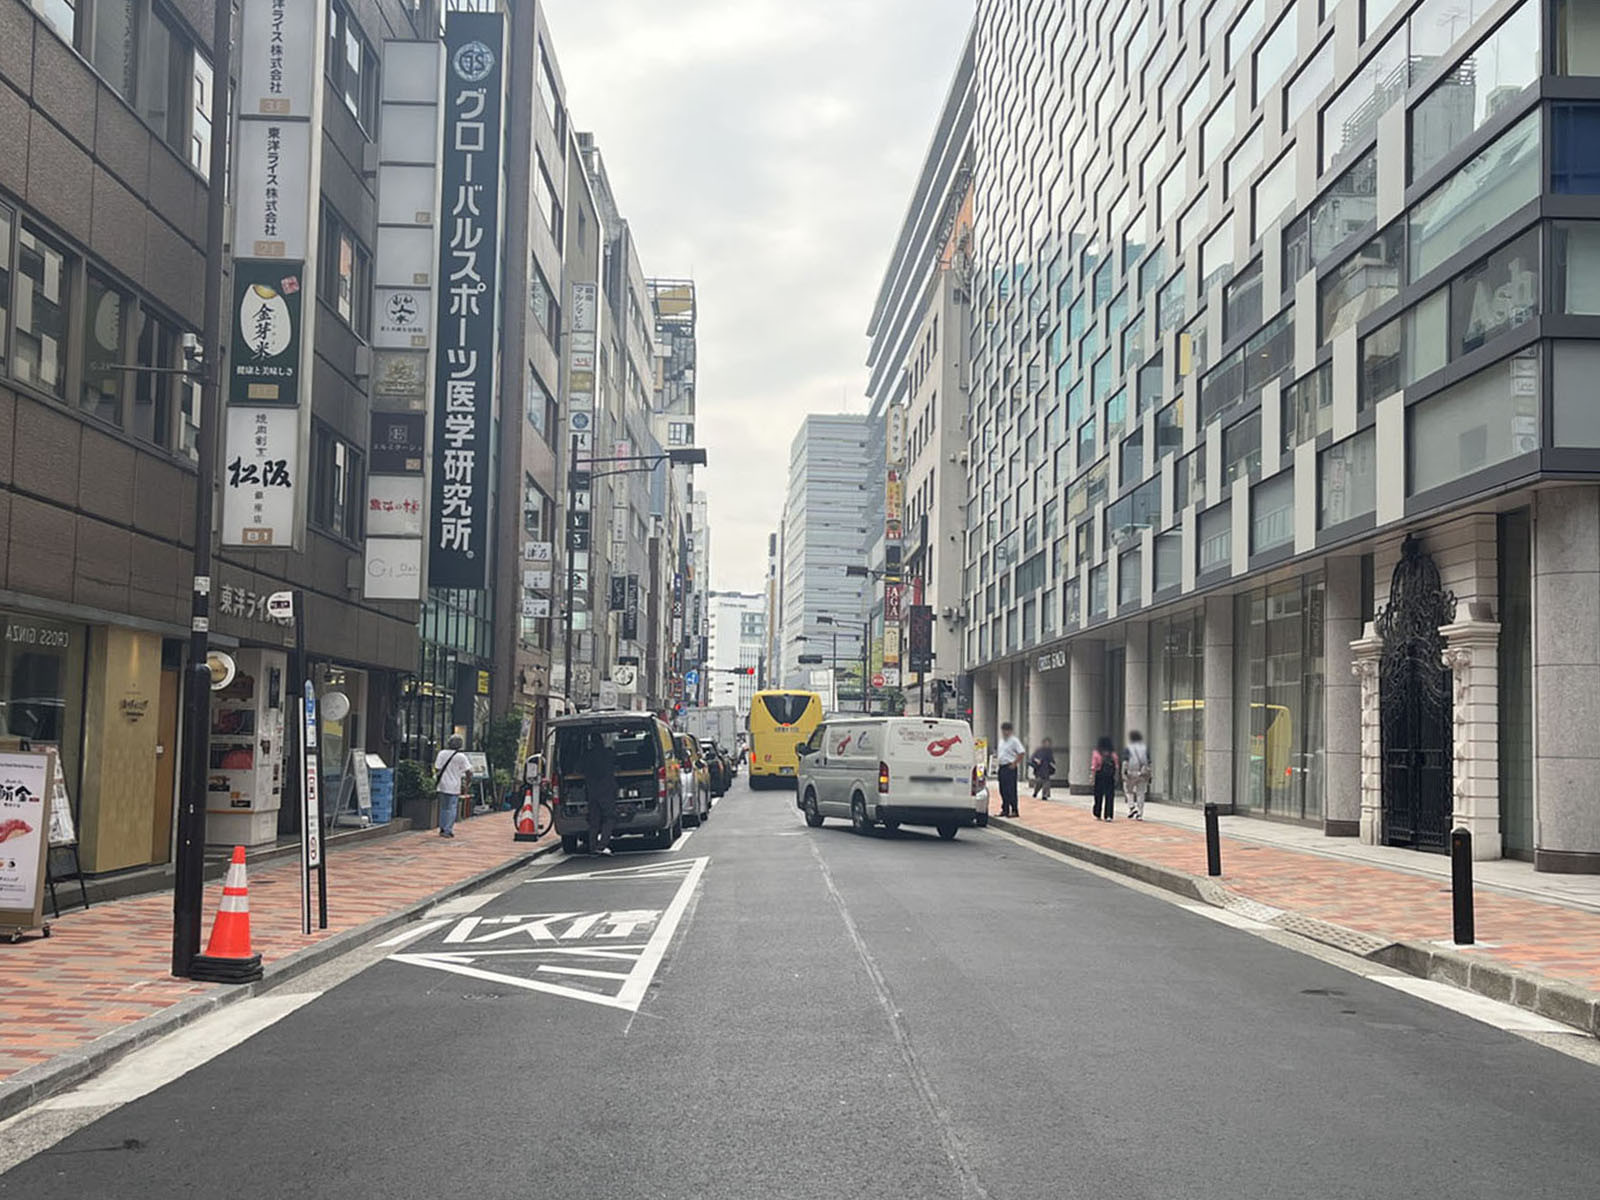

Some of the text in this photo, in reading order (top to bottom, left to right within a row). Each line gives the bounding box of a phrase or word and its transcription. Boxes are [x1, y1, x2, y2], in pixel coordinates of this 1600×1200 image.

[264, 127, 281, 237] 東洋ライス株式会社
[251, 303, 274, 360] 金芽米
[228, 456, 292, 488] 松阪
[218, 584, 296, 628] 東洋ライ
[889, 586, 898, 617] AGA
